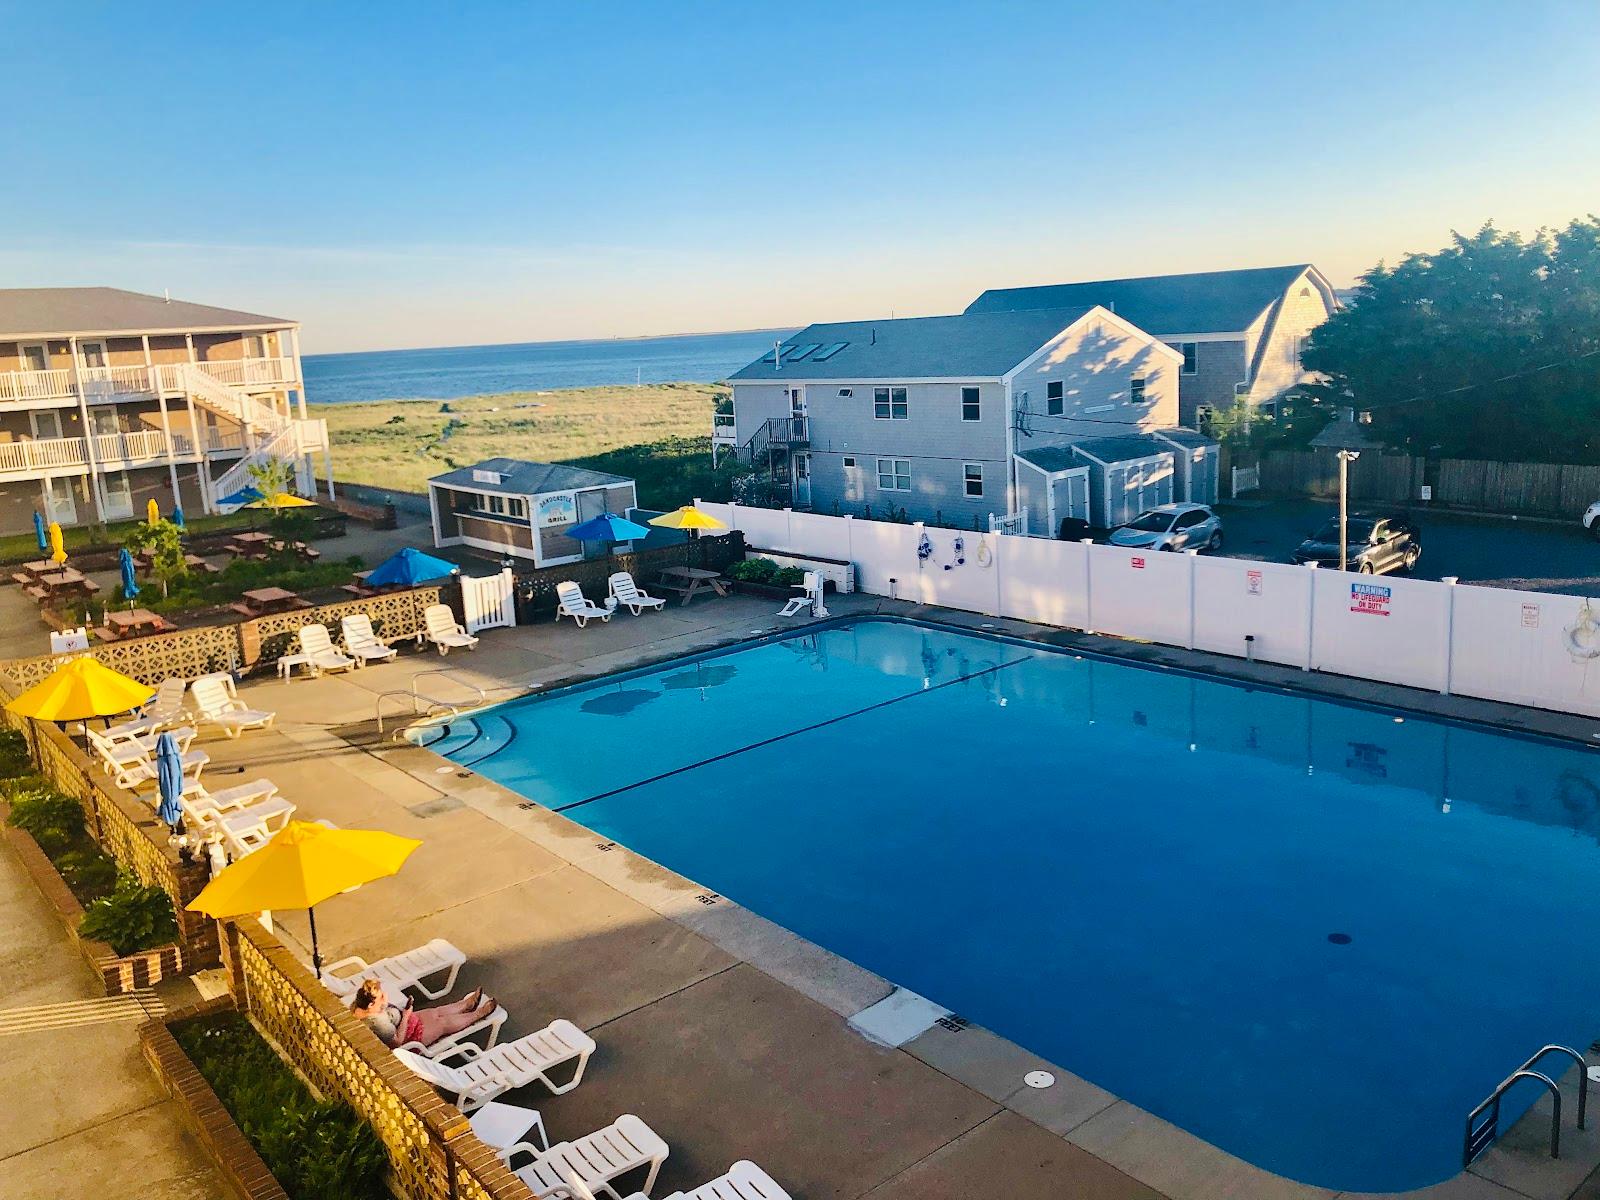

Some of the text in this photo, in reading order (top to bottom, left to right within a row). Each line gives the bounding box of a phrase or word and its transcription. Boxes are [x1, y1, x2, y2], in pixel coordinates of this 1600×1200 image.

[1354, 584, 1390, 598] WARNING
[1351, 592, 1390, 604] NO LIFEGUARD
[1367, 602, 1382, 610] DUTY
[695, 895, 717, 906] FEET
[934, 1017, 966, 1033] FEET
